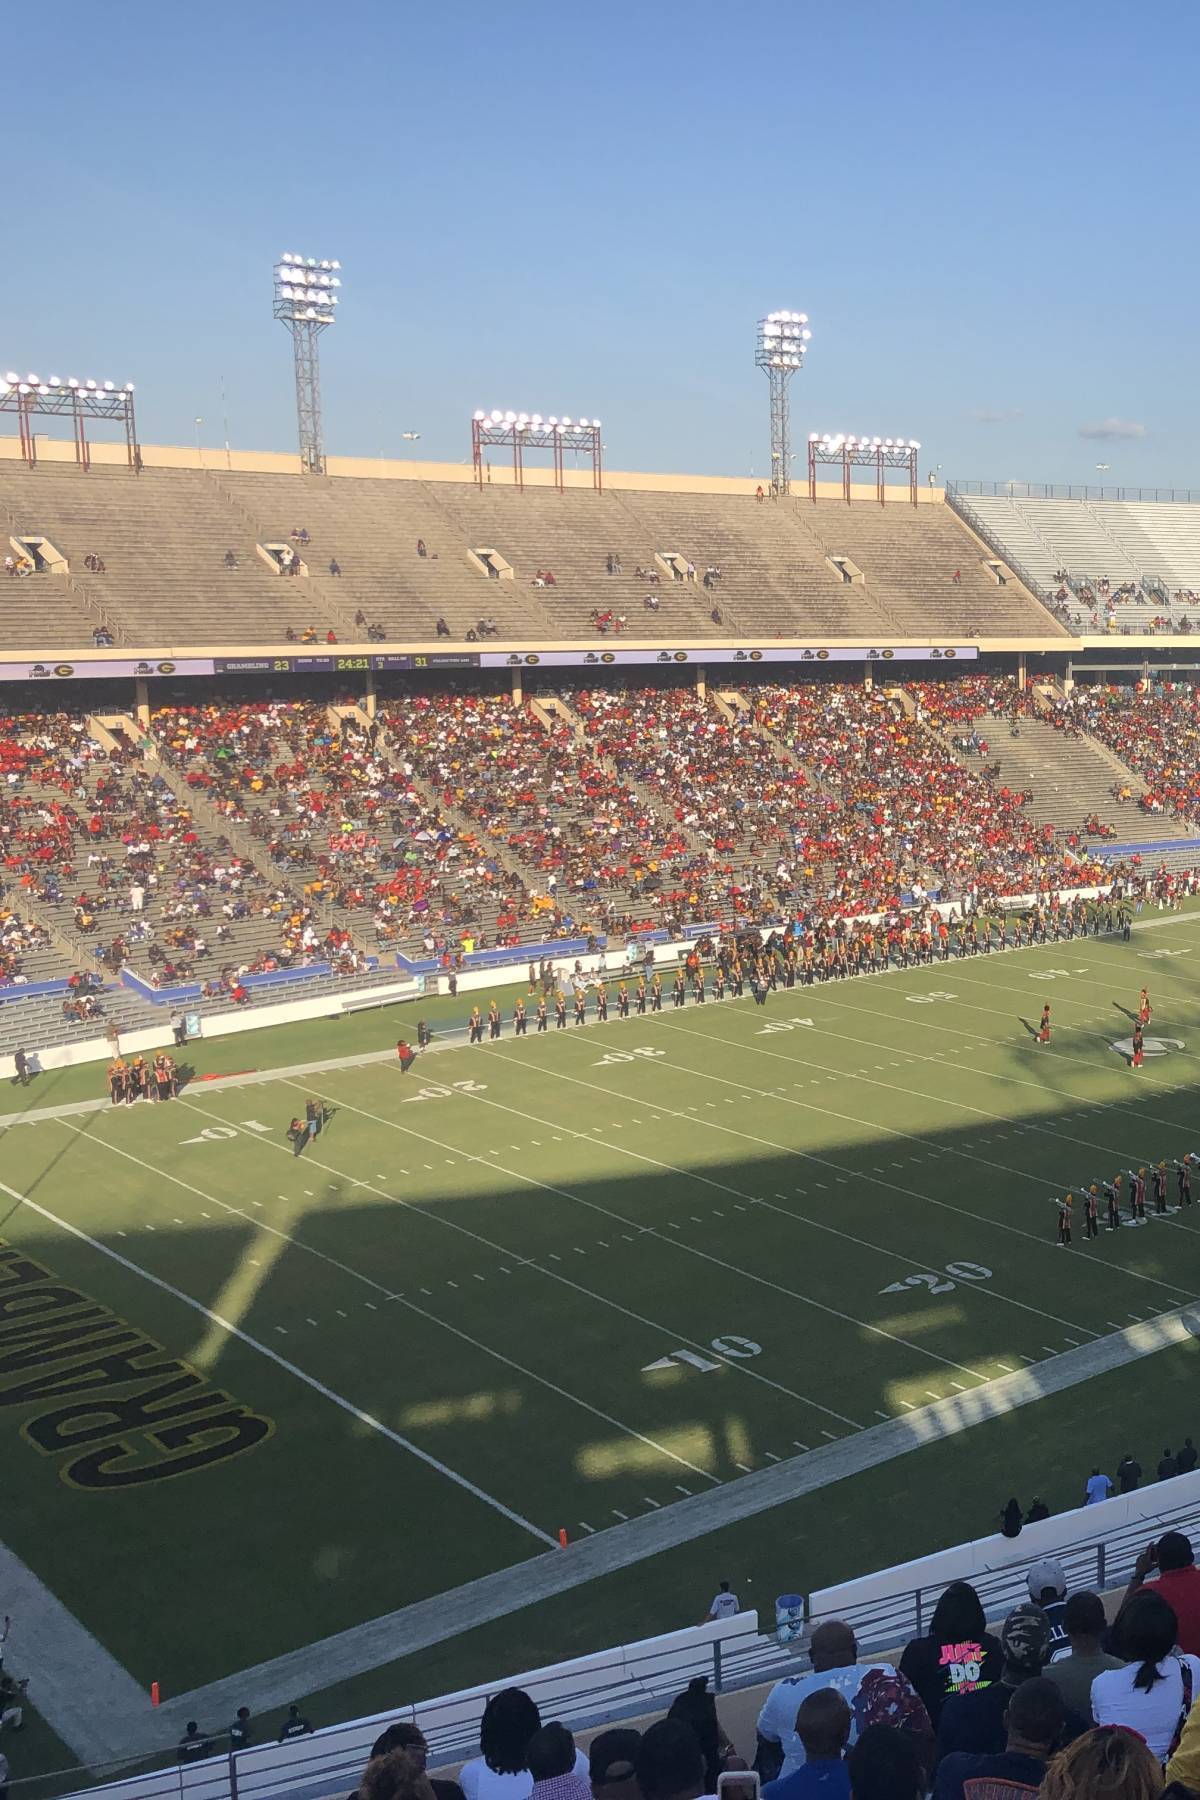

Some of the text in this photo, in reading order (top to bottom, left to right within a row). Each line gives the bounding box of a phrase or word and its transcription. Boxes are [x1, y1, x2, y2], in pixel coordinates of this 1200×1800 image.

[274, 660, 289, 670] 23
[338, 659, 370, 669] 24:21
[415, 657, 428, 667] 31
[418, 1079, 489, 1099] 20
[907, 1261, 993, 1295] 20
[670, 1335, 762, 1373] 10
[939, 1643, 982, 1665] JUST
[949, 1661, 980, 1684] DO
